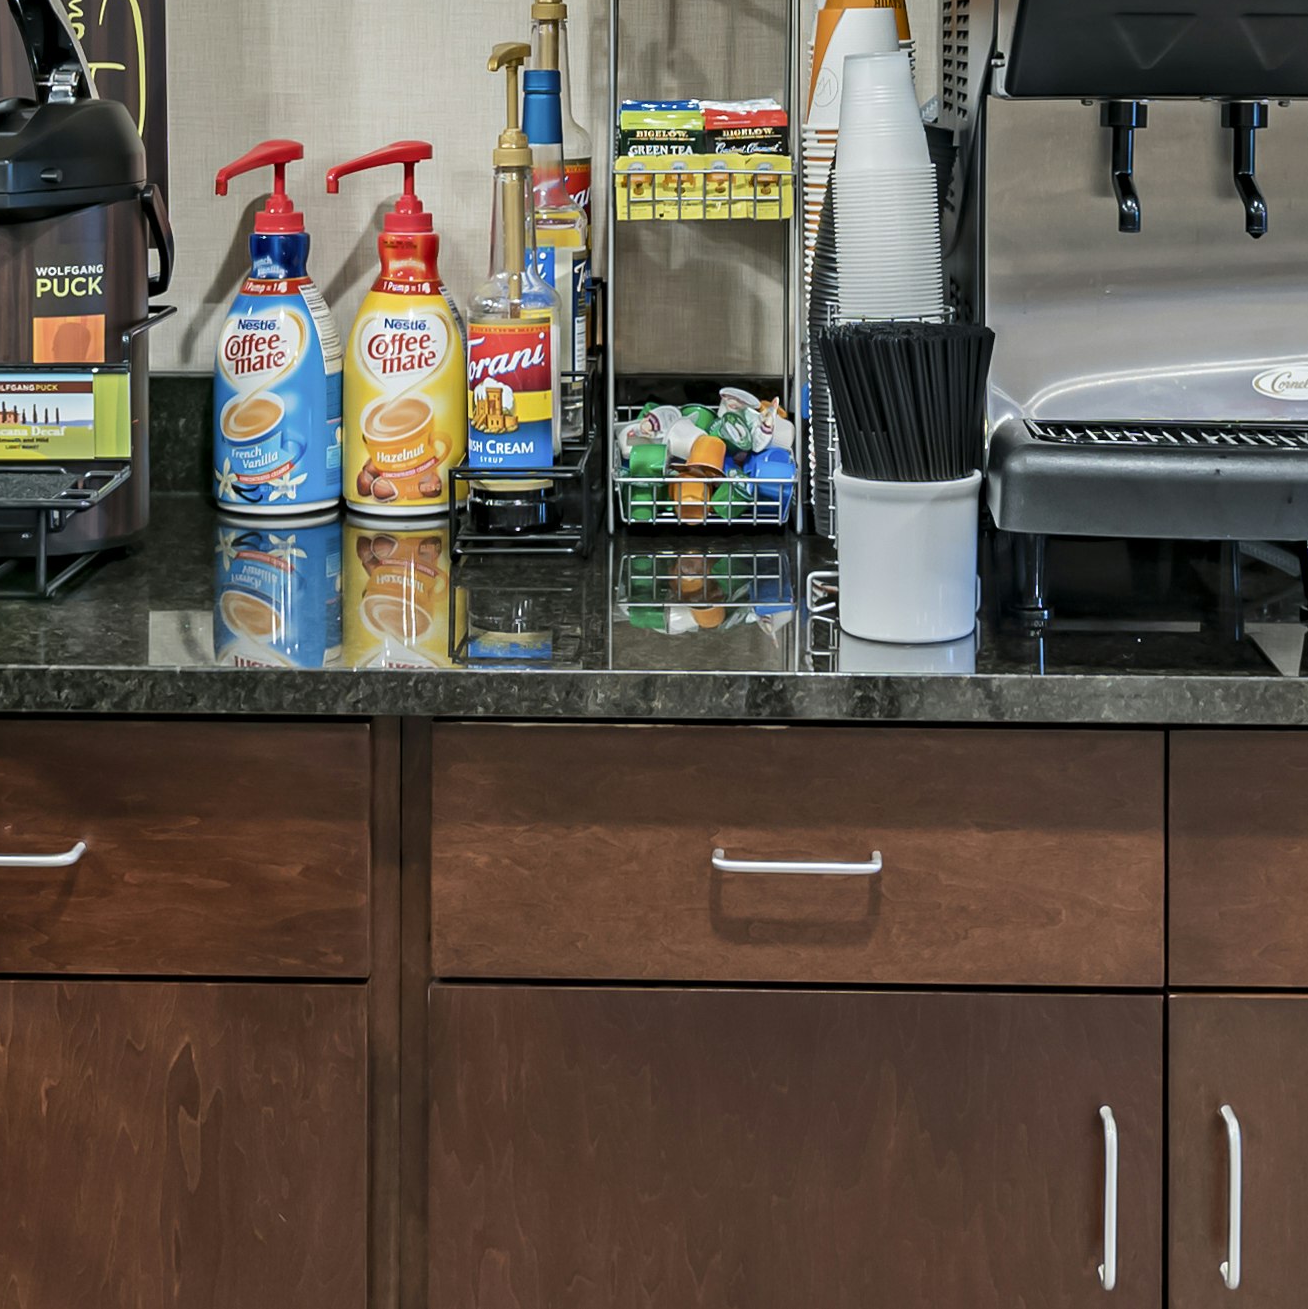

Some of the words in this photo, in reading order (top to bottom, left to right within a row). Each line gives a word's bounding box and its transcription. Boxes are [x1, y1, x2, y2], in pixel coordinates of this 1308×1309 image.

[629, 144, 669, 155] GREEN
[670, 144, 693, 155] TEA
[35, 263, 104, 277] WOLFGANG
[36, 276, 103, 298] PUCK
[387, 281, 410, 294] Pump
[234, 350, 286, 375] mate
[381, 349, 437, 374] mate
[31, 425, 67, 437] Decaf
[231, 446, 262, 459] French
[376, 443, 426, 463] Hazelnut
[485, 439, 534, 455] CREAM
[242, 451, 279, 469] Vanilla
